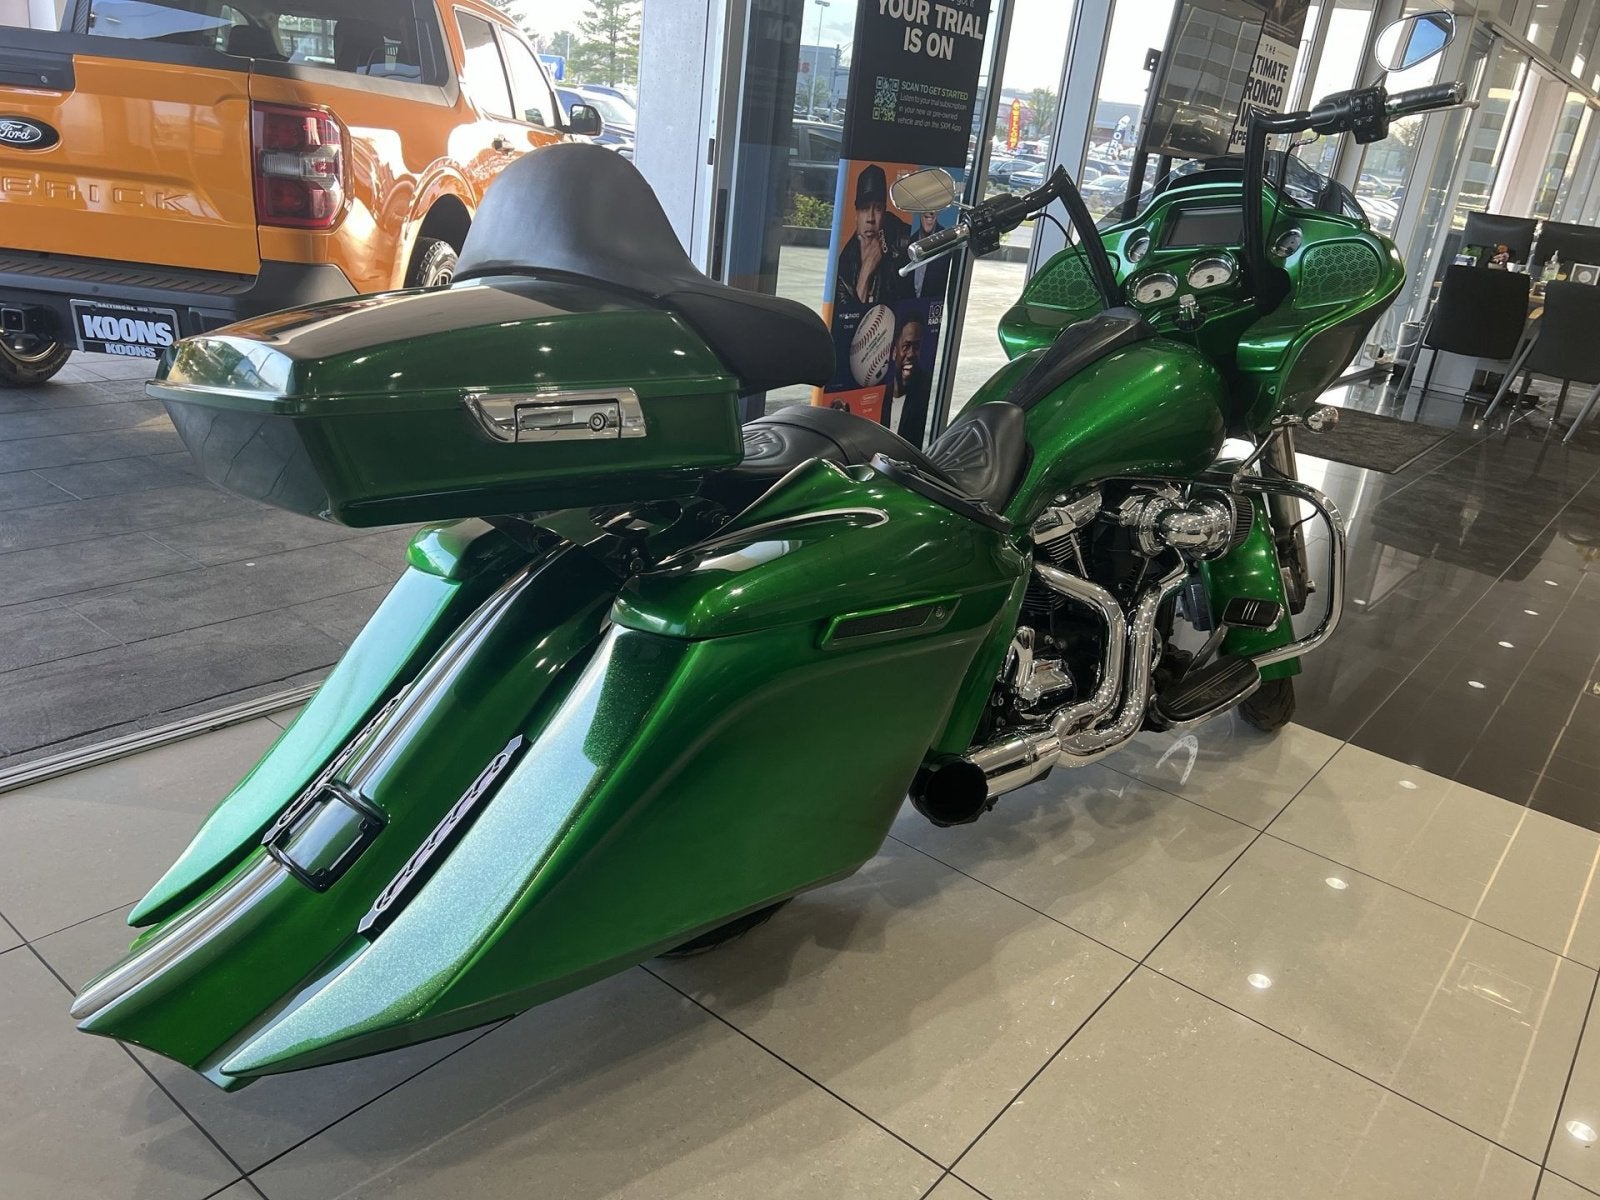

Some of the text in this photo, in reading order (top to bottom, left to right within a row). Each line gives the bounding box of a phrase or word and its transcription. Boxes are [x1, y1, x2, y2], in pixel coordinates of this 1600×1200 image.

[935, 3, 984, 40] TRIAL
[904, 26, 955, 61] IS ON
[1265, 43, 1276, 55] THE
[1250, 54, 1289, 83] TIMATE
[901, 80, 969, 101] SCAN TO GET STARTED
[0, 121, 31, 140] Ford
[82, 314, 174, 347] KOONS
[104, 343, 157, 358] KOONS
